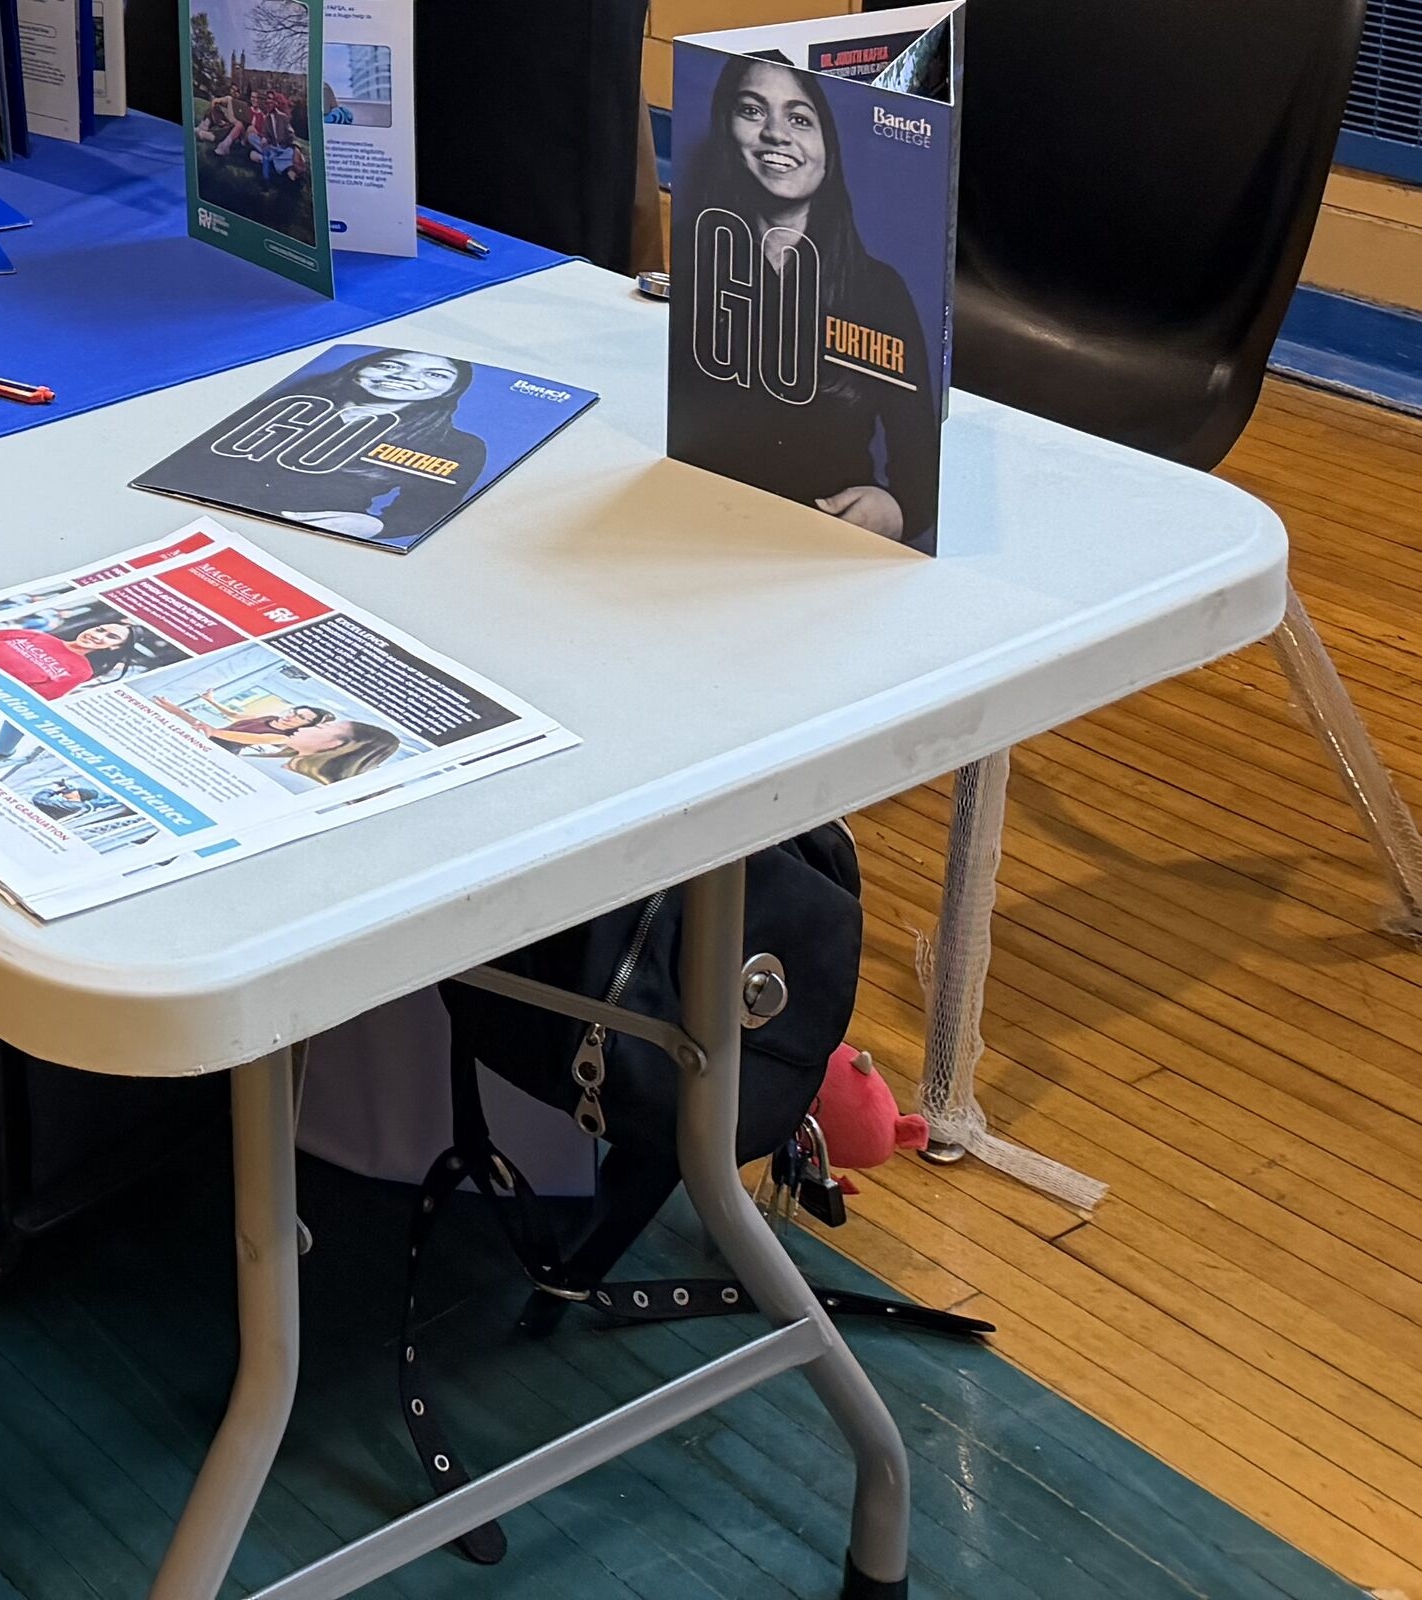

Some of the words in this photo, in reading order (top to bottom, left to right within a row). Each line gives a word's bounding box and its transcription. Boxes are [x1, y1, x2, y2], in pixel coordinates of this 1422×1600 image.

[873, 124, 931, 148] COLLEGE
[874, 106, 932, 136] Baruch
[693, 207, 819, 405] GO
[825, 314, 905, 374] FURTHER
[211, 394, 400, 474] GO
[367, 442, 460, 477] FURTHER
[198, 563, 272, 604] MACAULAY
[218, 584, 257, 608] COLLEGE
[334, 617, 390, 648] EXCELLENCE
[12, 639, 71, 677] MACAULAY
[114, 689, 169, 726] EXPERIENTIAL
[168, 723, 211, 753] LEARNING
[36, 718, 103, 765] Through
[96, 759, 193, 826] Experience
[3, 792, 17, 804] AT
[15, 802, 71, 842] GRADUATION
